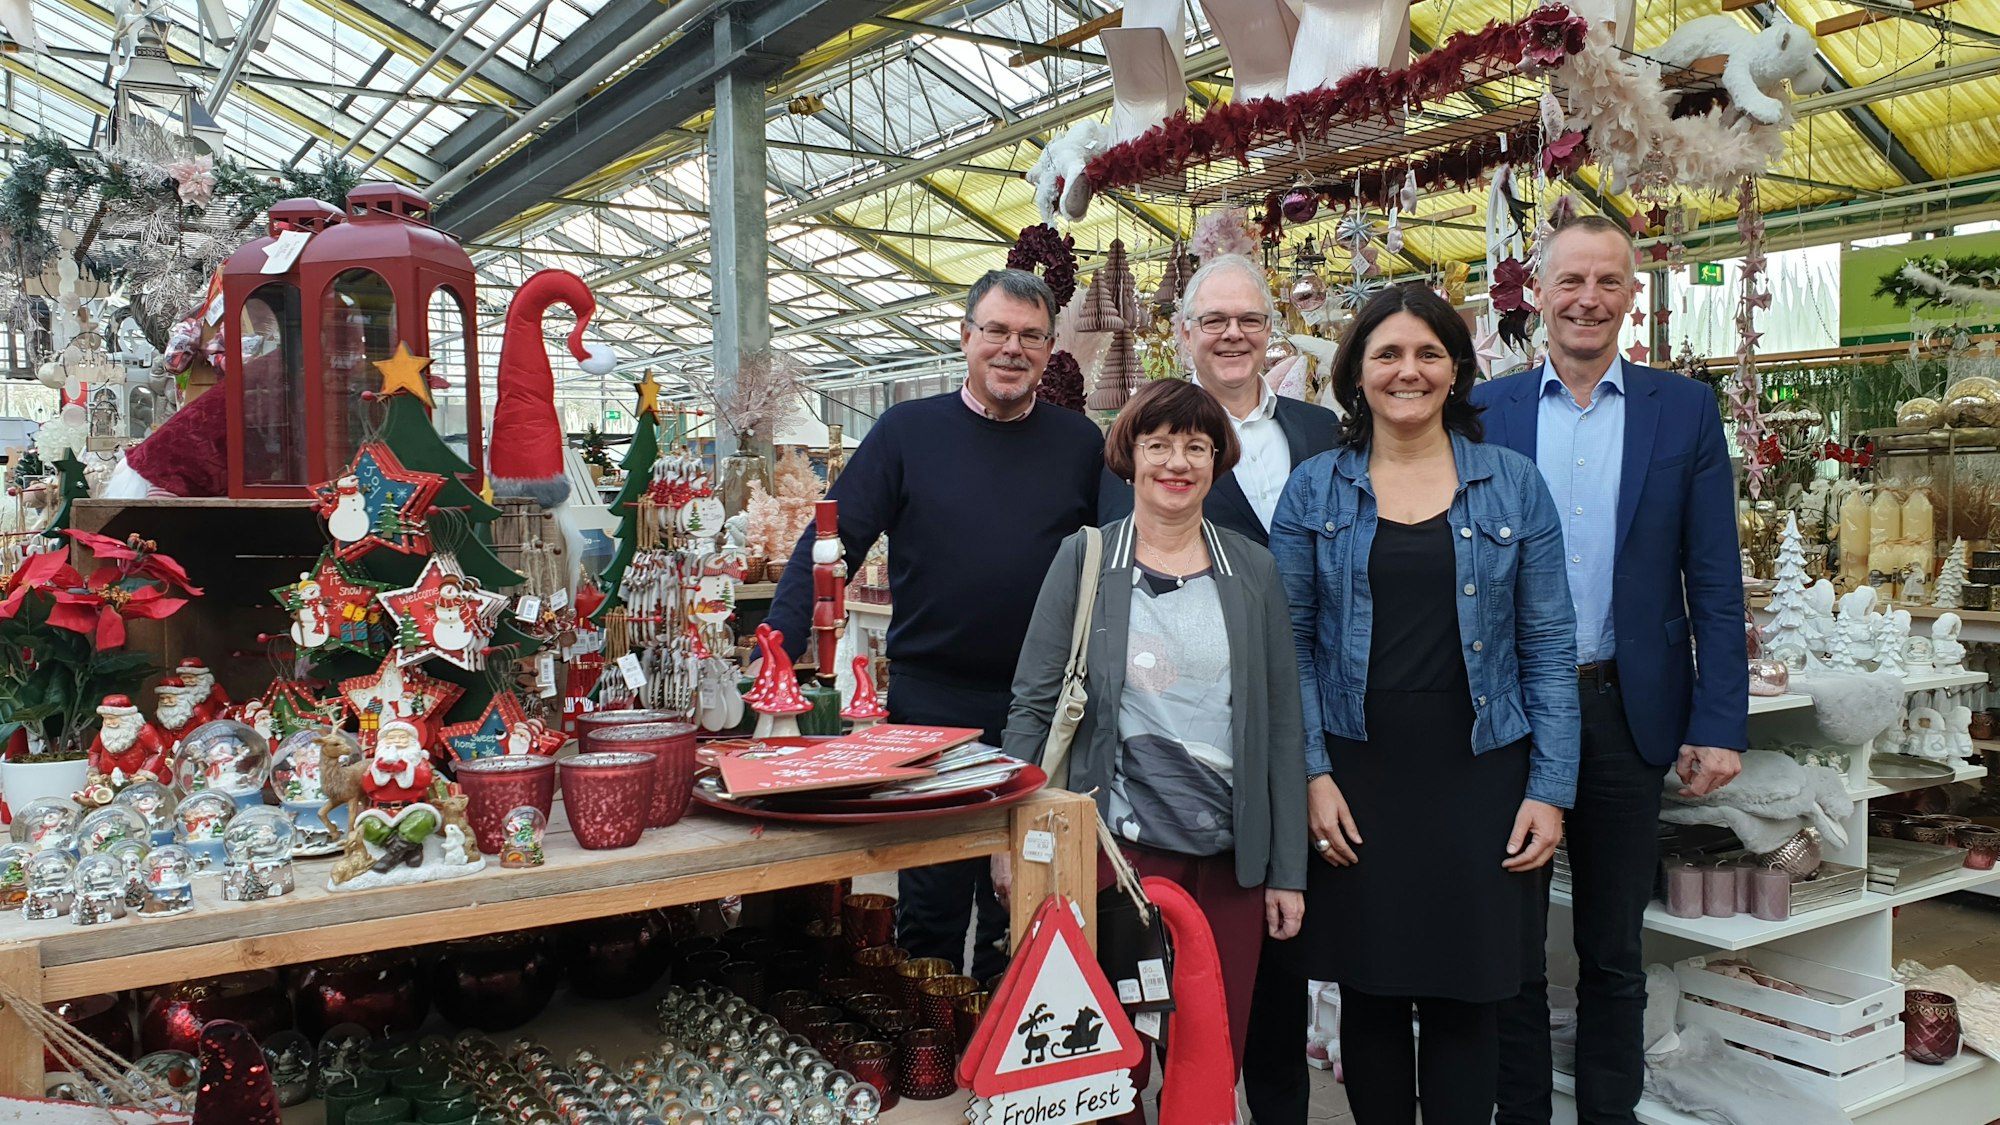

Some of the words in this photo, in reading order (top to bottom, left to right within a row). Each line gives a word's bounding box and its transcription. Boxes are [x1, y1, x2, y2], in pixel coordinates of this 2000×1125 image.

[322, 565, 338, 574] Let
[330, 575, 342, 586] it
[886, 729, 945, 737] HALLO
[454, 739, 477, 749] home
[825, 742, 922, 753] GESCHENKE
[812, 754, 870, 762] HIER
[1003, 1096, 1066, 1125] Frohes
[1075, 1083, 1120, 1116] Fest
